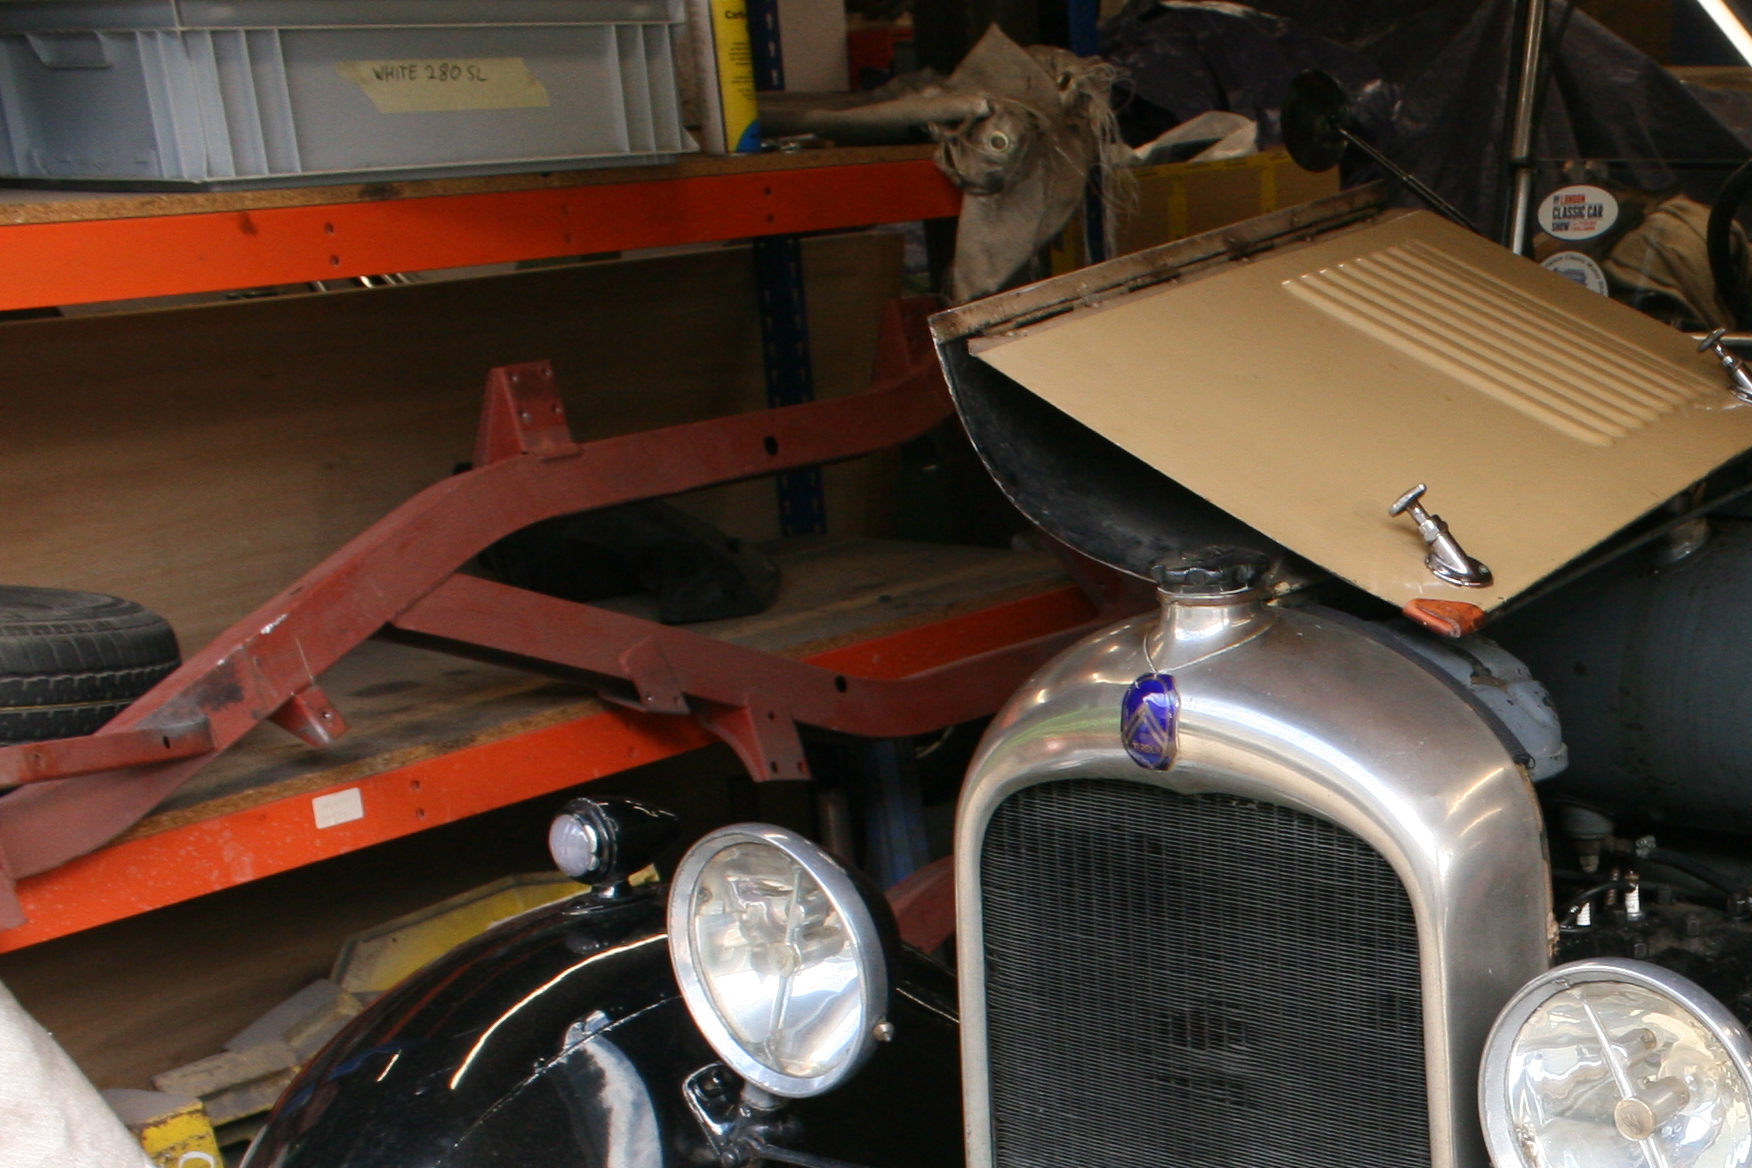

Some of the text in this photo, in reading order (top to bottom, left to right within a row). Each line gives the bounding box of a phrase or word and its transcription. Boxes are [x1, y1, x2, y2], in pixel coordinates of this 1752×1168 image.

[372, 63, 488, 82] WHITE 280 SL
[1552, 204, 1604, 220] CLASSIC CAR
